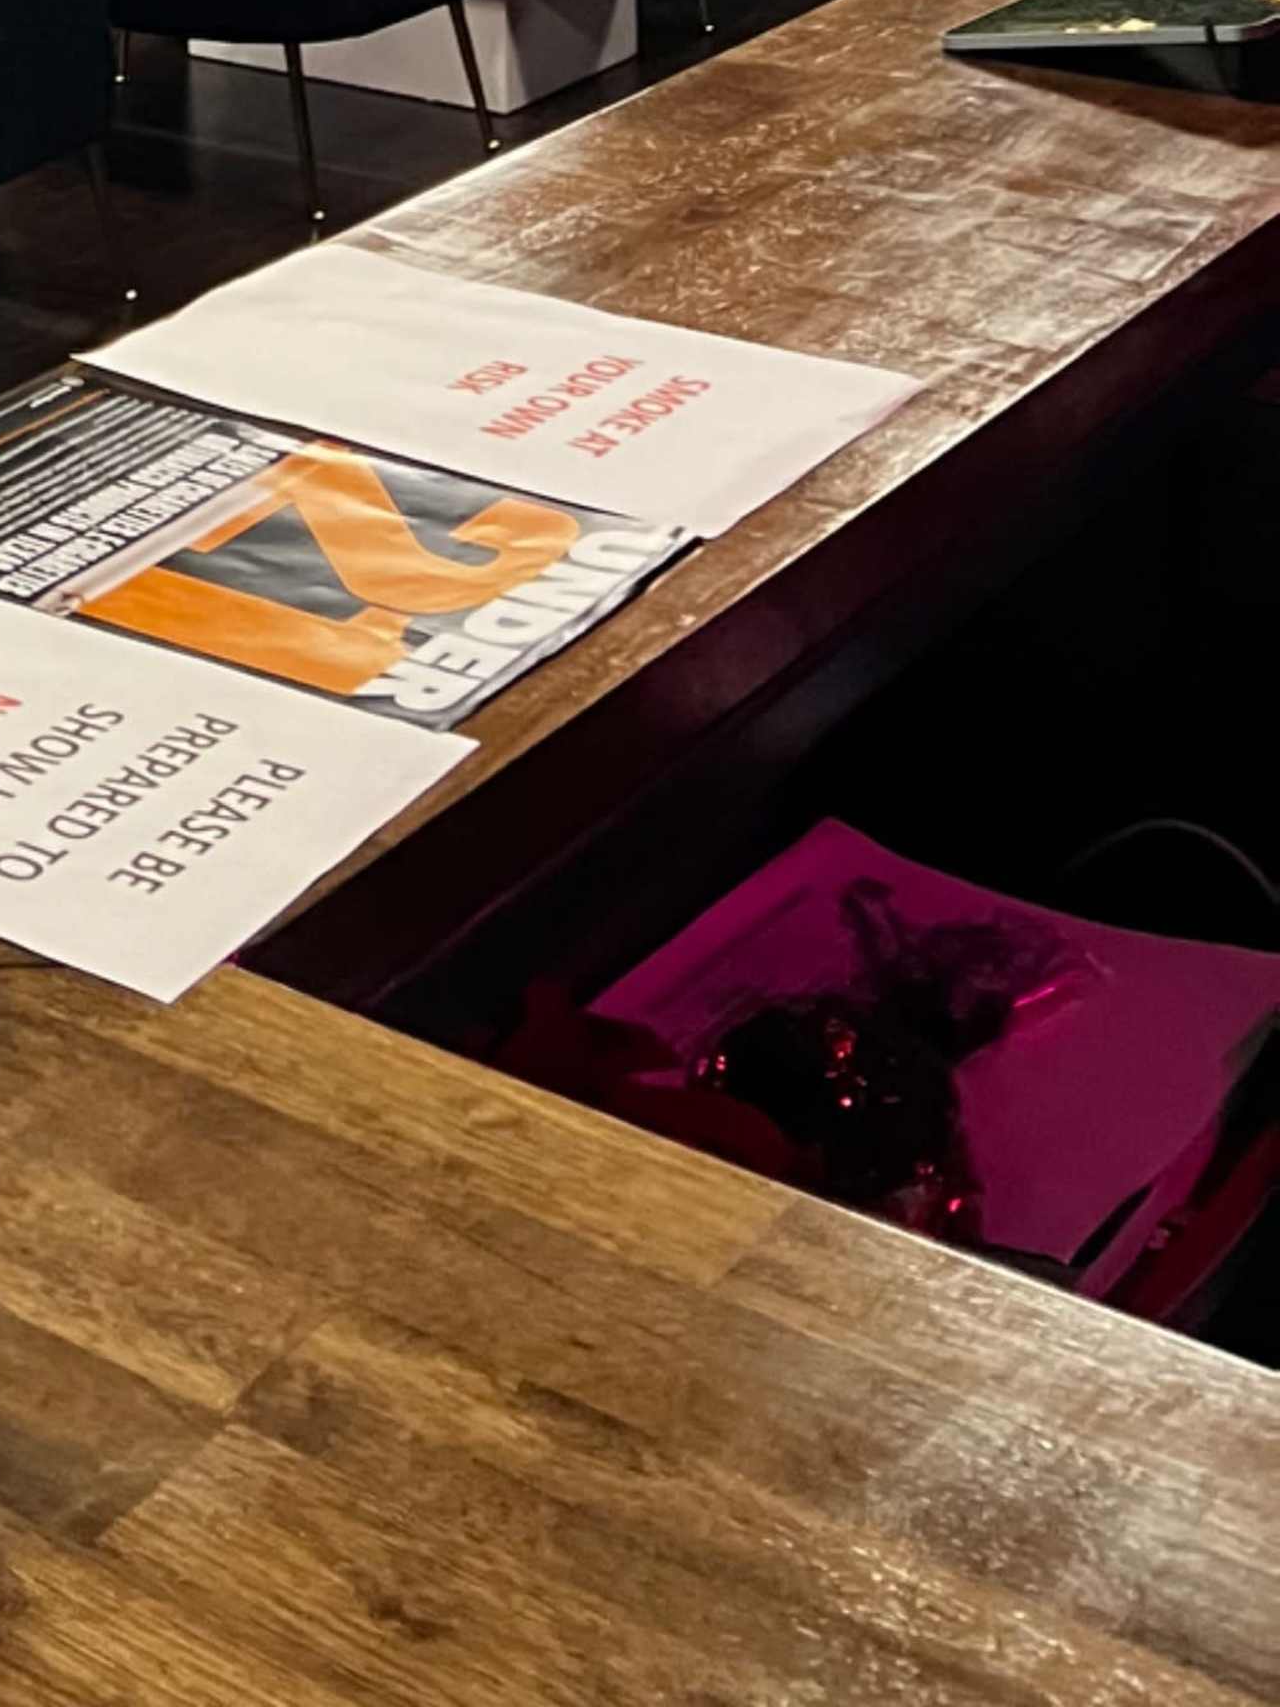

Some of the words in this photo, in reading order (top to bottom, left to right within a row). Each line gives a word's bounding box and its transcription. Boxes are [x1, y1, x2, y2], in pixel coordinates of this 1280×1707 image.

[447, 360, 529, 395] RISK
[546, 354, 645, 398] YOUR
[478, 394, 570, 440] OWN
[597, 374, 711, 436] SMOKE
[565, 429, 620, 458] AT
[77, 439, 581, 696] 21
[354, 528, 664, 714] UNDER
[46, 712, 239, 840] PREPARED
[157, 758, 307, 856] PLEASE
[106, 851, 186, 895] BE
